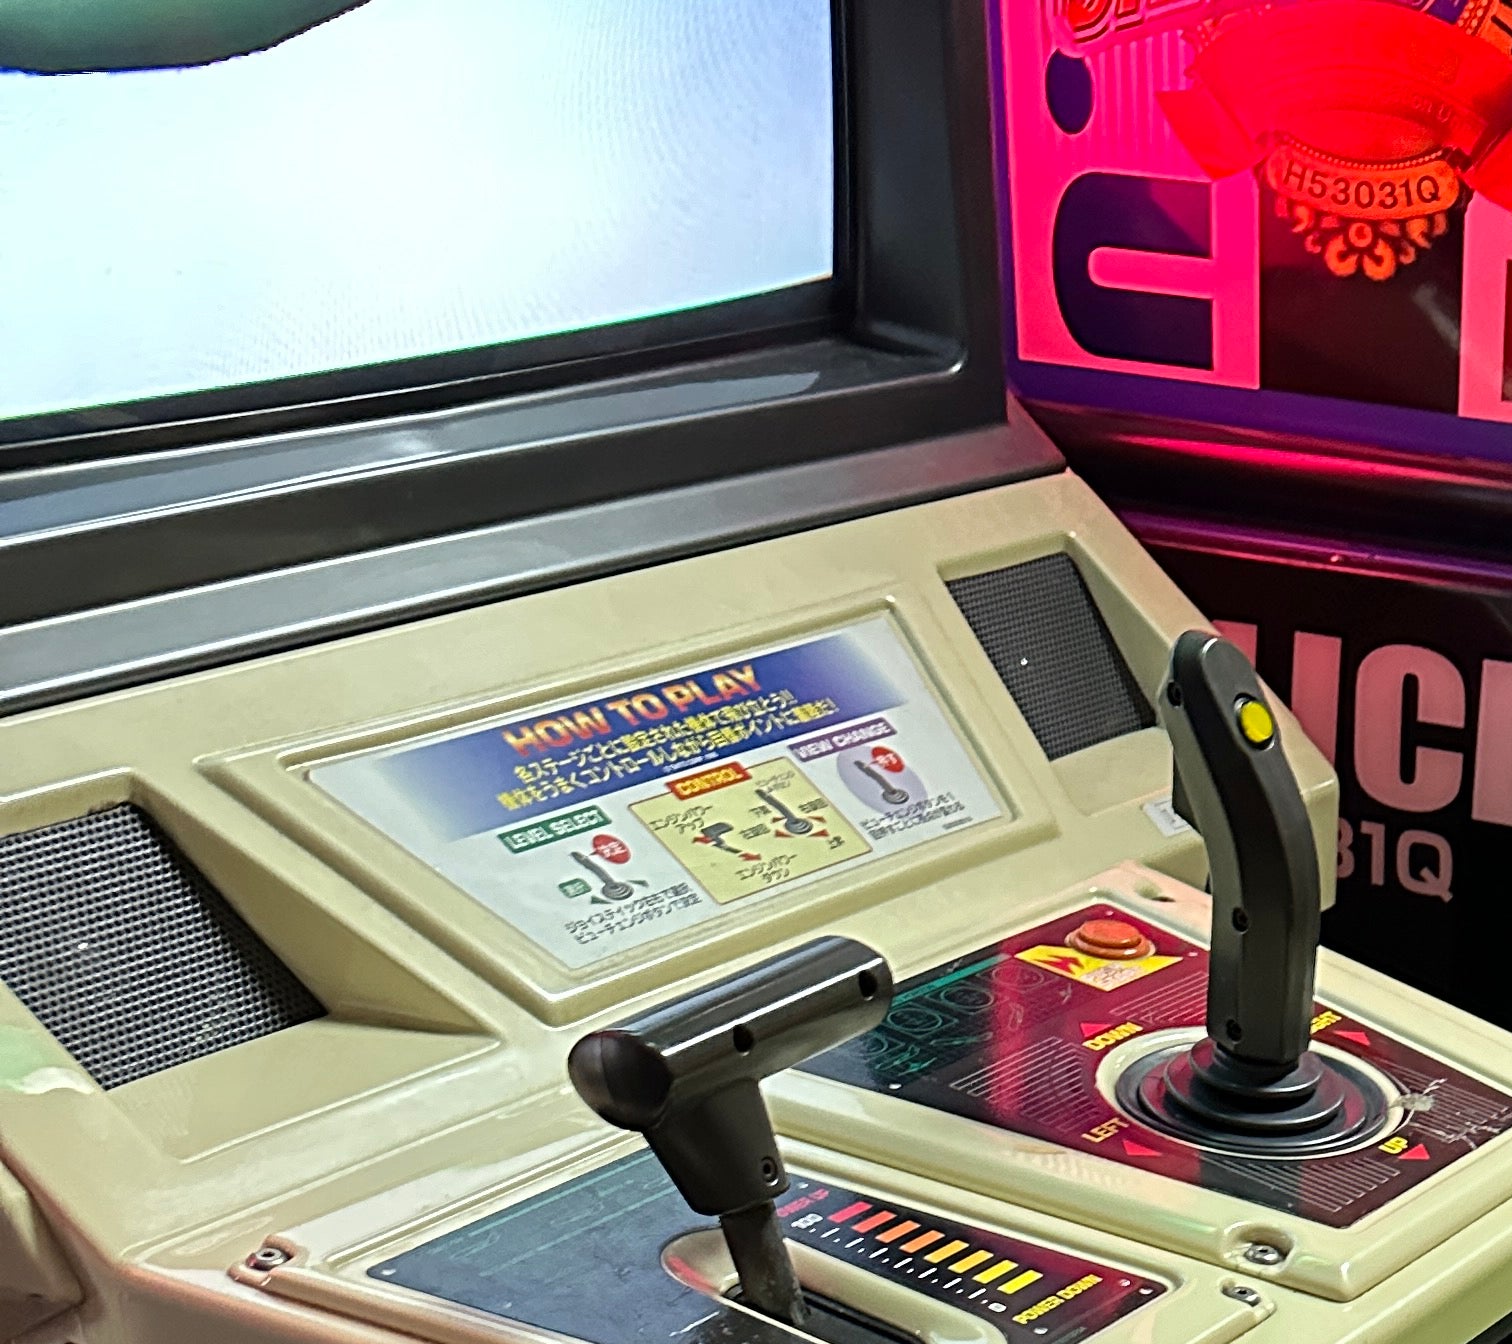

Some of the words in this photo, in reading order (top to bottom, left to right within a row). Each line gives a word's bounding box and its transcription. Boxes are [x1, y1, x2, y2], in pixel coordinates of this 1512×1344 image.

[1282, 155, 1442, 209] H53031Q
[502, 706, 612, 757] HOW
[608, 689, 670, 727] TO
[661, 664, 762, 713] PLAY
[794, 738, 834, 760] VIEW
[831, 720, 892, 748] CHANGE
[674, 766, 744, 796] CONTROL
[503, 825, 554, 850] LEVEL
[548, 809, 606, 836] SELECT
[1082, 1021, 1144, 1051] DOWN
[1081, 1117, 1130, 1143] LEFT
[1378, 1136, 1408, 1155] UP
[1011, 1295, 1065, 1325] POWER
[1057, 1273, 1104, 1300] DOWN
